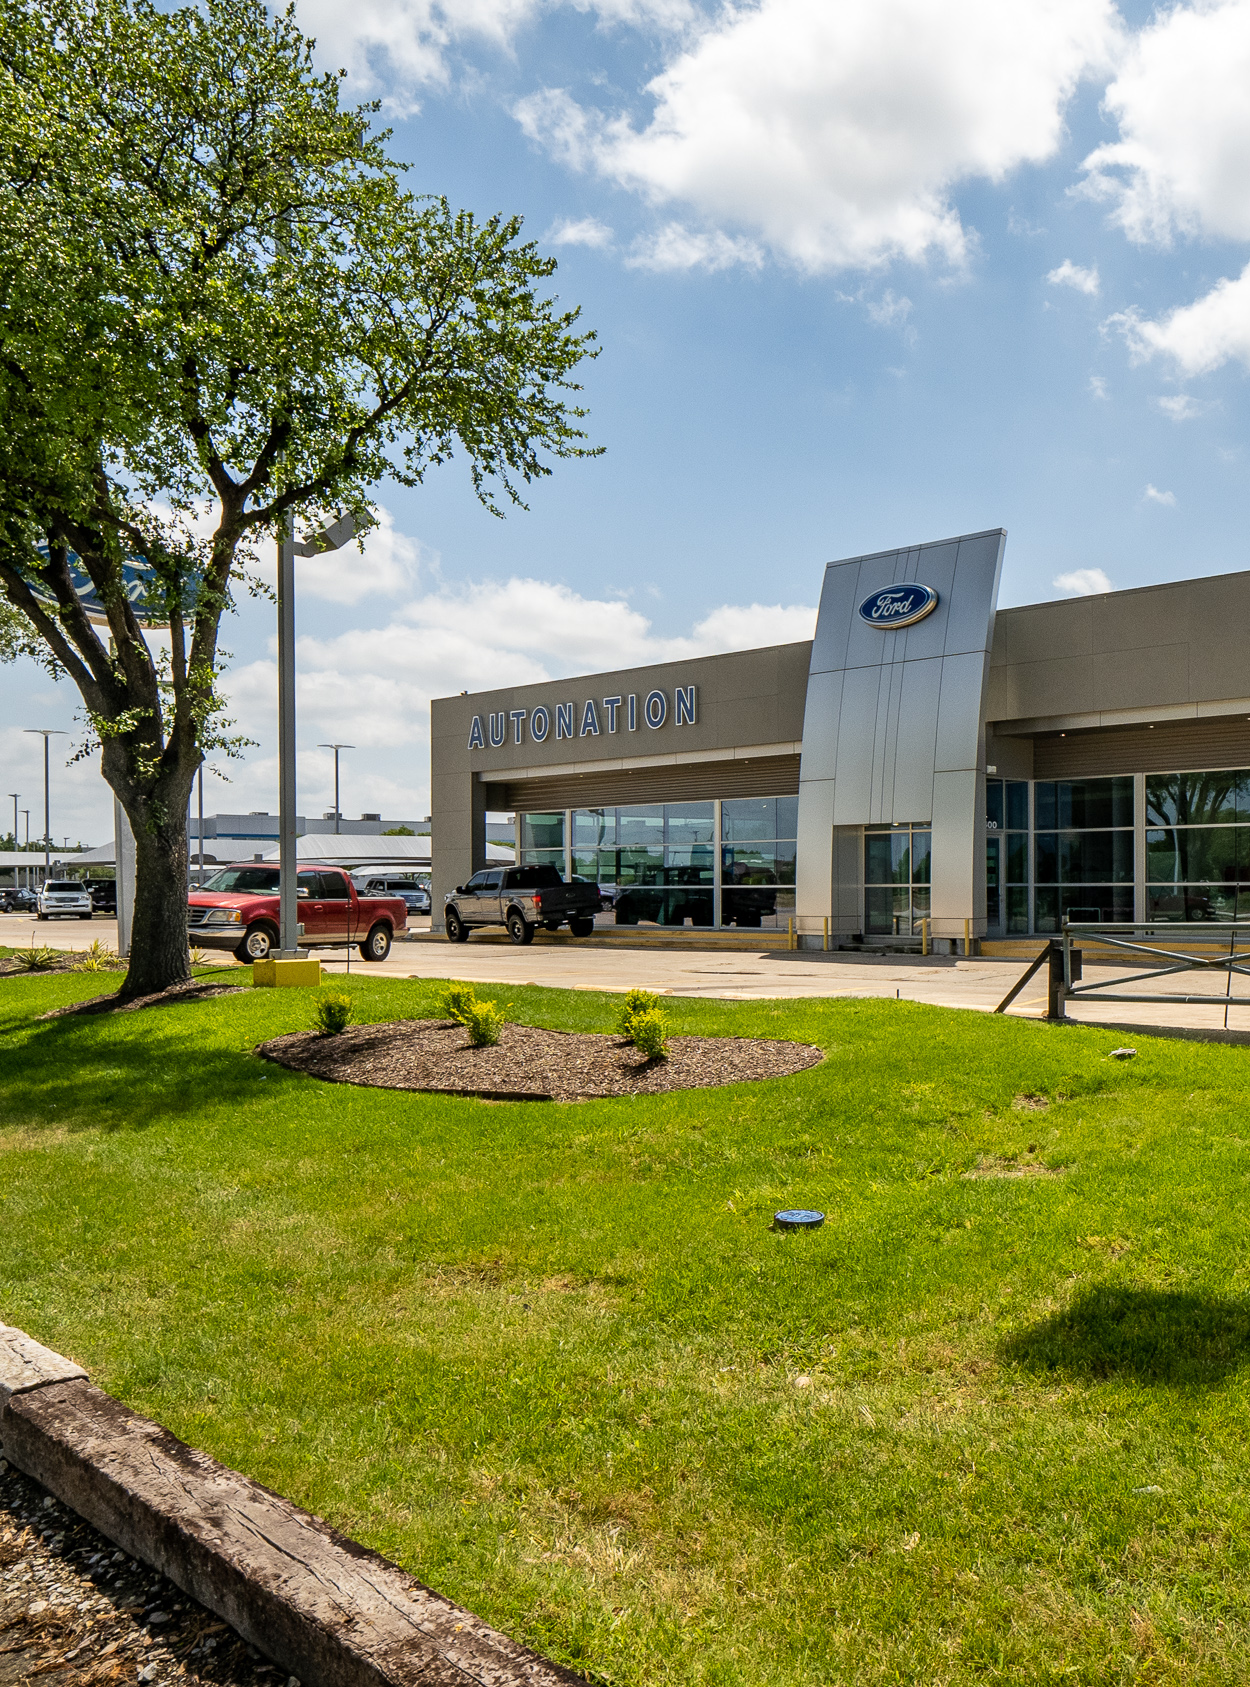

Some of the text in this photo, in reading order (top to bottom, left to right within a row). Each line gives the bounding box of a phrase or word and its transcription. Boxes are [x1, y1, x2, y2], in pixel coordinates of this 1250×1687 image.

[872, 592, 914, 618] Ford
[467, 685, 697, 750] AUTONATION
[986, 820, 998, 829] 00
